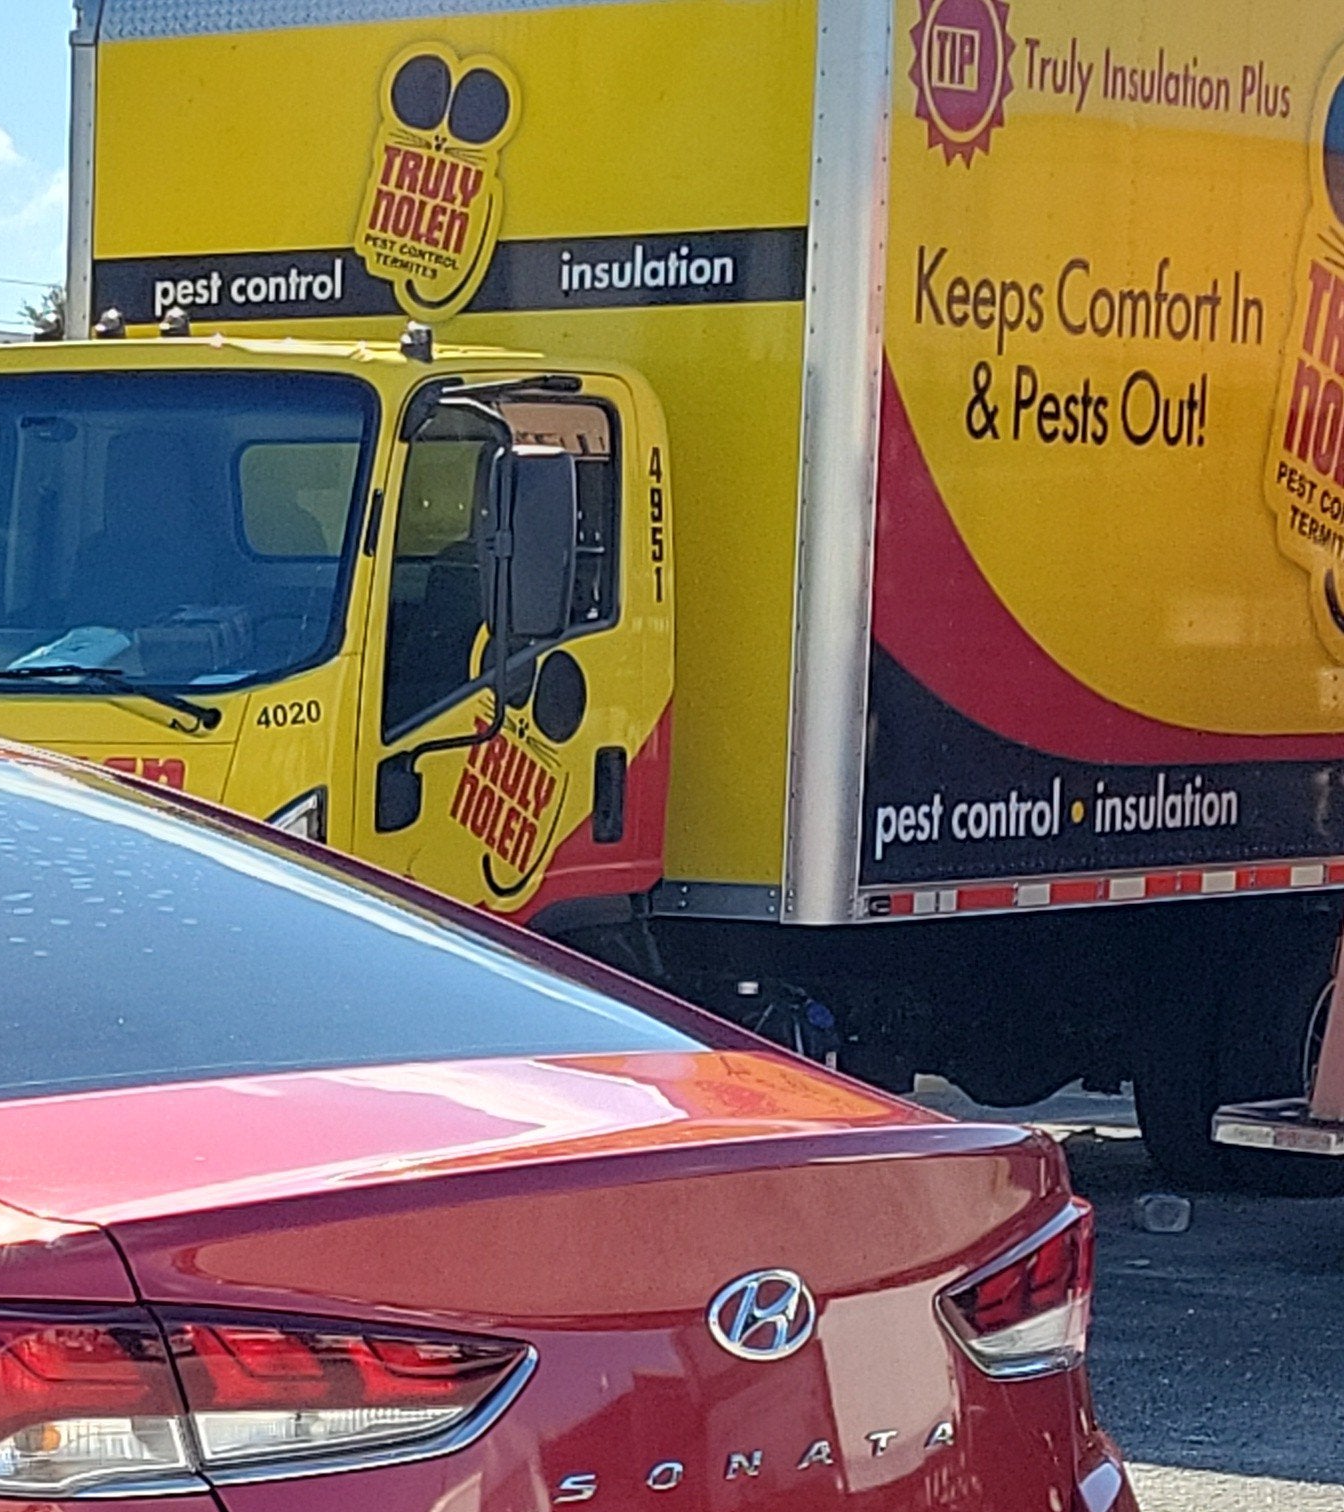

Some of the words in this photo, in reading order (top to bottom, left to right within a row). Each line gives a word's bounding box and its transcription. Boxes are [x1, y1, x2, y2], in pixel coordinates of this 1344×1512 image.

[937, 30, 975, 85] TIP
[1025, 37, 1095, 113] Truly
[1103, 47, 1230, 112] Insulation
[1240, 60, 1291, 119] Plus
[380, 144, 484, 208] TRULY
[364, 233, 397, 253] PEST
[399, 243, 460, 271] CONTROL
[368, 187, 470, 255] NOLEN
[154, 271, 222, 317] pest
[230, 257, 342, 304] control
[561, 244, 734, 291] insulation
[914, 244, 1045, 356] Keeps
[1056, 256, 1222, 344] Comfort
[1230, 270, 1264, 345] In
[965, 360, 1000, 441] &
[1012, 364, 1109, 445] Pests
[1121, 368, 1208, 447] Out!
[1276, 460, 1318, 504] PEST
[649, 446, 663, 603] 4951
[256, 700, 322, 729] 4020
[467, 715, 557, 821] TRULY
[450, 766, 538, 874] NOLEN
[875, 793, 943, 861] pest
[951, 777, 1061, 840] control
[1095, 772, 1238, 833] insulation
[553, 1420, 955, 1503] SONATA
